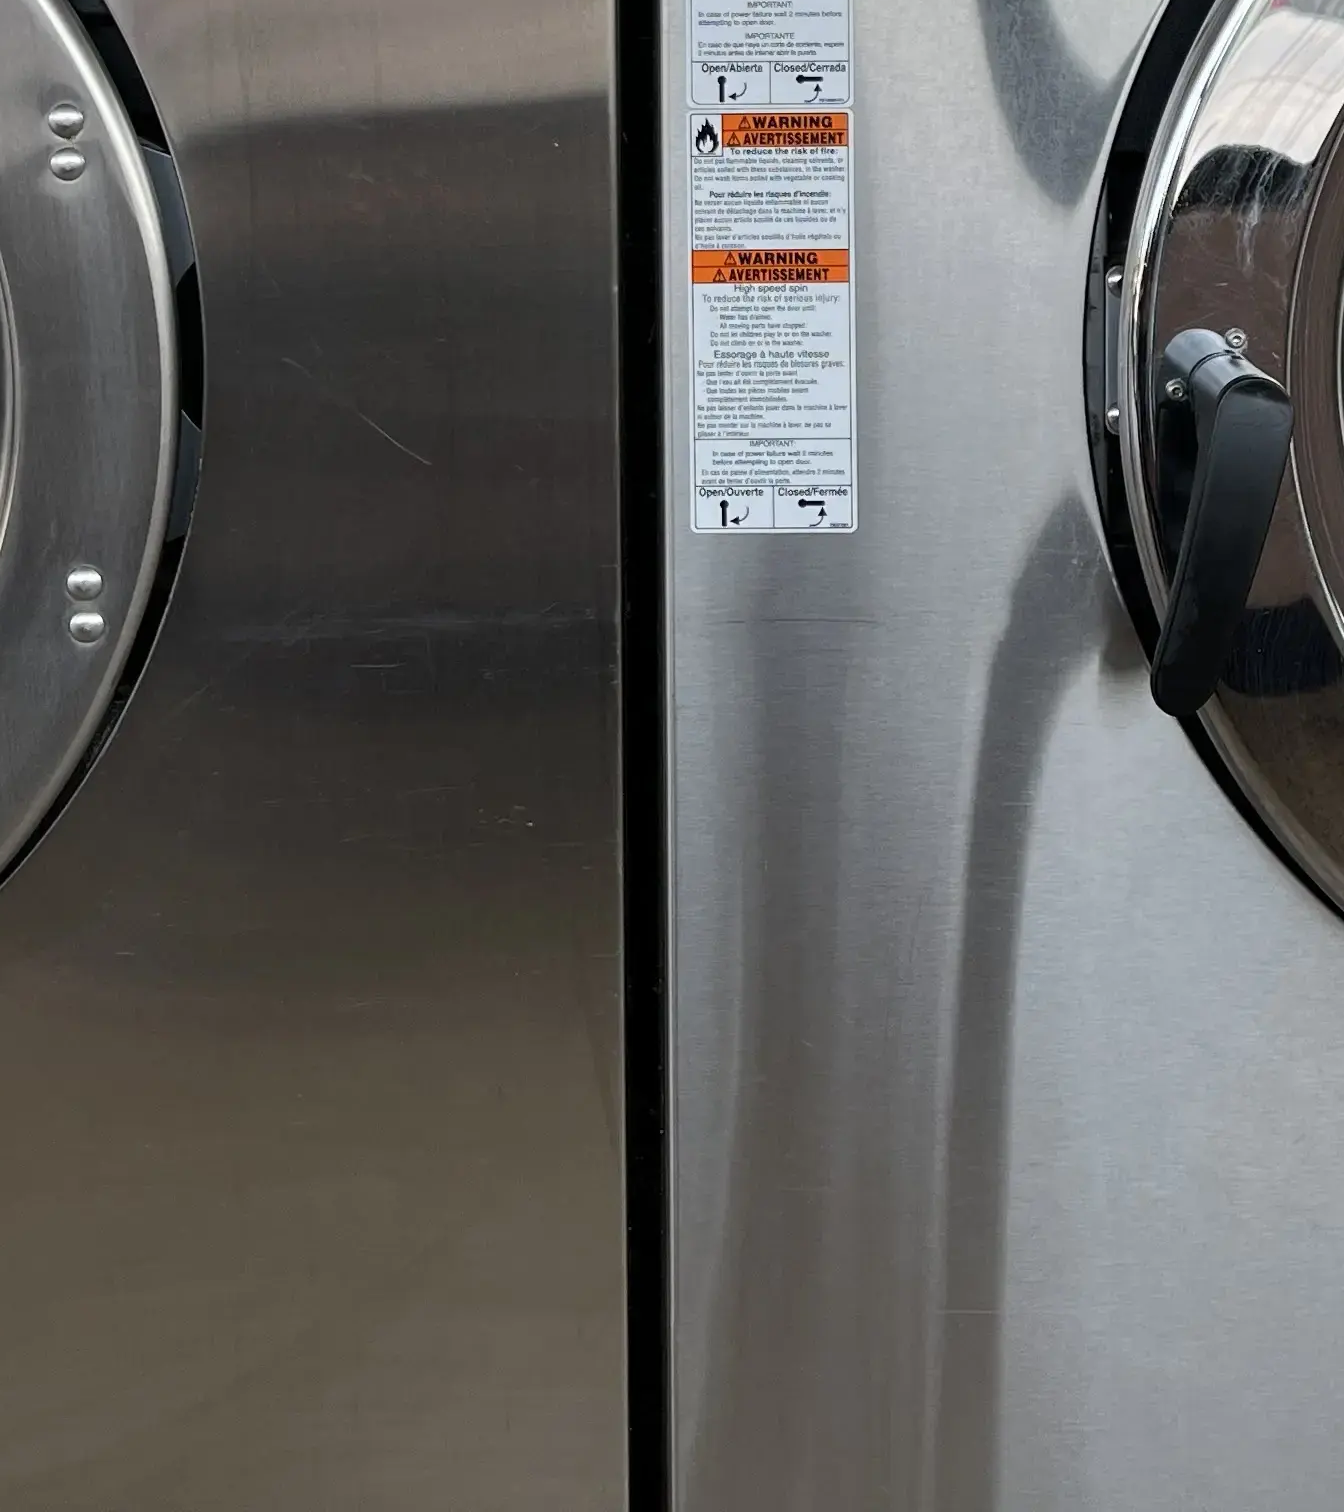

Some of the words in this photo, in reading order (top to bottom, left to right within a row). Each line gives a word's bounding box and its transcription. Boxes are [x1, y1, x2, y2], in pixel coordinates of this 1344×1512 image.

[774, 62, 846, 73] Closed/Cerrada
[751, 116, 833, 128] WARNING
[743, 132, 844, 145] AVERTISSEMENT
[730, 147, 740, 155] To
[743, 147, 773, 155] reduce
[775, 147, 789, 155] the
[791, 147, 807, 155] risk
[810, 147, 818, 155] of
[820, 147, 838, 155] fire:
[738, 252, 818, 265] WARNING
[729, 268, 830, 281] AVERTISSEMENT
[734, 284, 756, 294] High
[758, 284, 786, 294] speed
[788, 284, 808, 293] spin
[713, 350, 757, 360] Essorage
[759, 350, 766, 358] à
[768, 350, 794, 358] haute
[797, 350, 829, 358] vitesse
[699, 487, 764, 498] Open/Ouverte
[777, 486, 848, 497] Closed/Fermée
